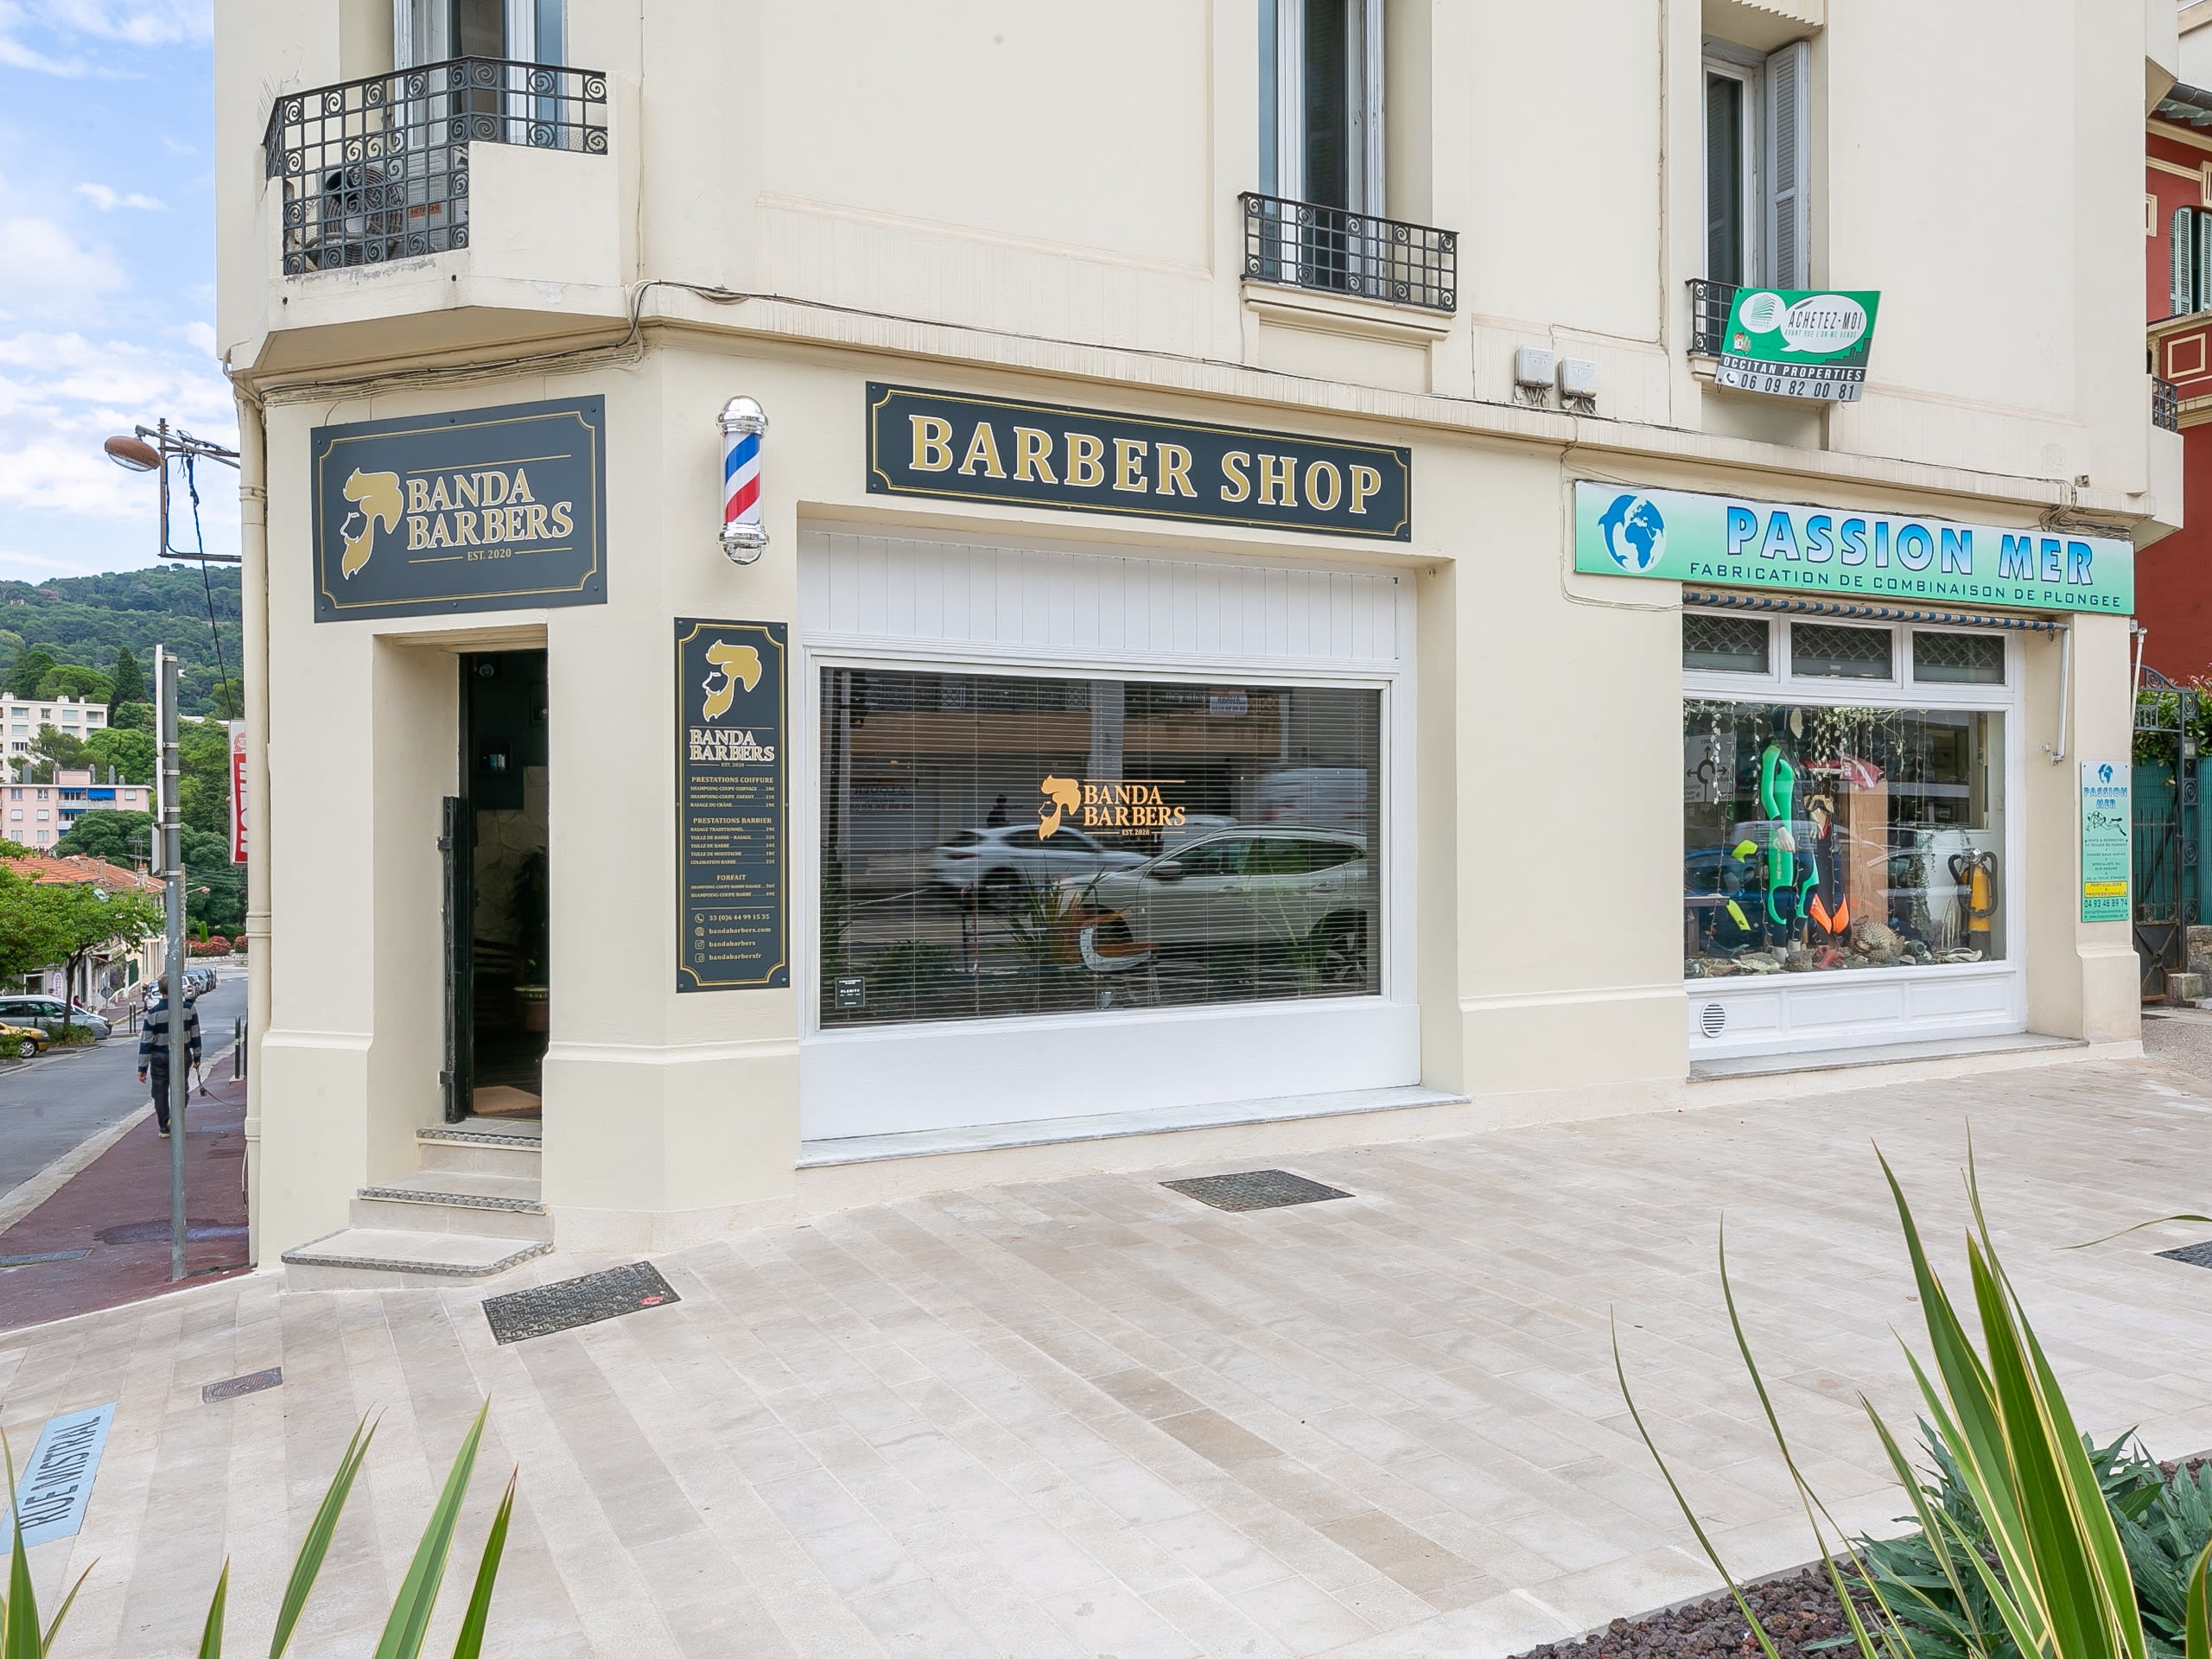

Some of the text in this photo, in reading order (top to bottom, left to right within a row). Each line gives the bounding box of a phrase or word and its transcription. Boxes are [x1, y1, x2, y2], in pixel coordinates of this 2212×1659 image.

[1788, 311, 1863, 330] ACHETEZ-MOI
[1723, 356, 1862, 381] OCCITAN PROPERTIES
[1740, 373, 1854, 400] 06 09 82 00 81
[908, 414, 1382, 515] BARBER SHOP
[406, 467, 536, 514] BANDA
[406, 500, 574, 550] BARBERS
[467, 548, 512, 562] EST. 2020
[1727, 505, 2094, 586] PASSION MER
[1690, 563, 2121, 608] FABRICATION DE COMBINAISON DE PLONGEE
[690, 729, 757, 746] BANDA
[689, 745, 775, 762] BARBERS
[1084, 785, 1163, 805] BANDA
[2083, 786, 2127, 797] PASSION
[2096, 798, 2116, 809] MER
[1084, 806, 1186, 826] BARBERS
[2084, 899, 2091, 908] 04
[19, 1415, 101, 1530] RUE MISTRAL
